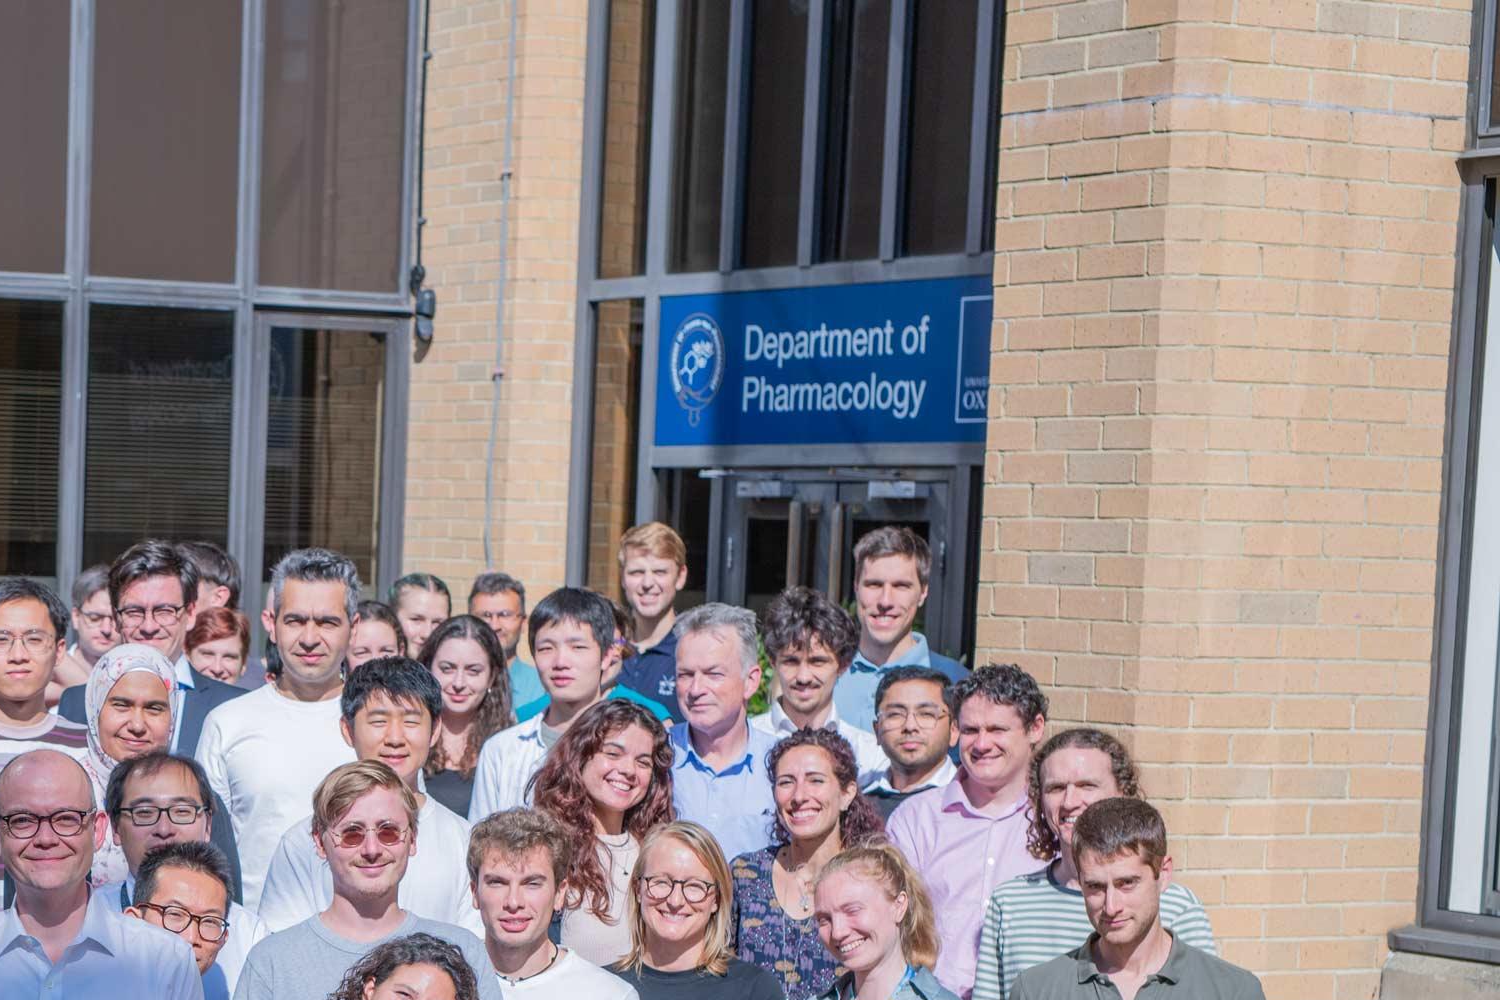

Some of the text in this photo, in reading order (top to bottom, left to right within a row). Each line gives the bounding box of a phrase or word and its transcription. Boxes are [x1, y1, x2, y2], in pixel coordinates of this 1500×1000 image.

[744, 319, 895, 369] Department
[901, 314, 931, 355] of
[742, 371, 927, 419] Pharmacology
[962, 390, 986, 410] OX
